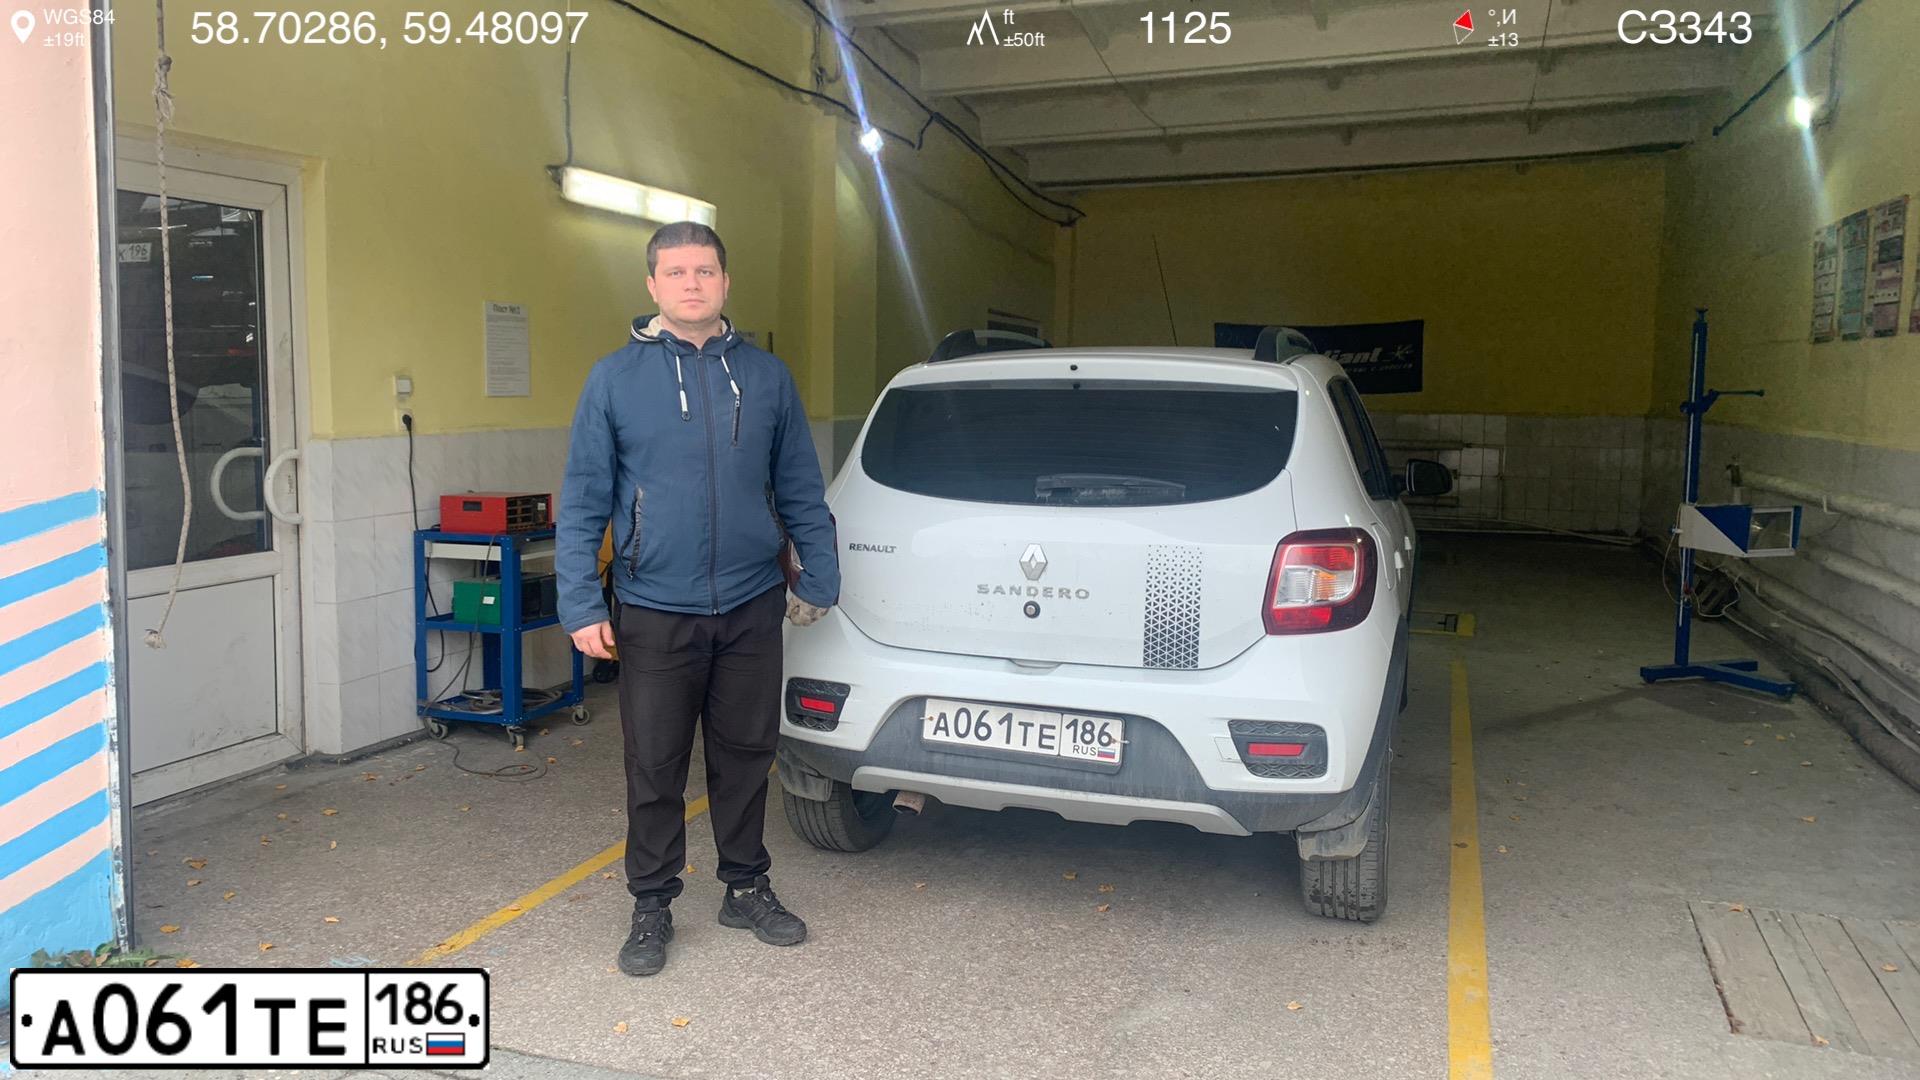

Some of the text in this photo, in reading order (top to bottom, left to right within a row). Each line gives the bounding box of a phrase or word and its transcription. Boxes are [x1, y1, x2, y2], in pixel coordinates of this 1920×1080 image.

[848, 542, 897, 554] RENAULT
[976, 583, 1091, 600] SANDERO
[932, 707, 1113, 751] А061ТЕ 186
[1072, 744, 1097, 756] RUS
